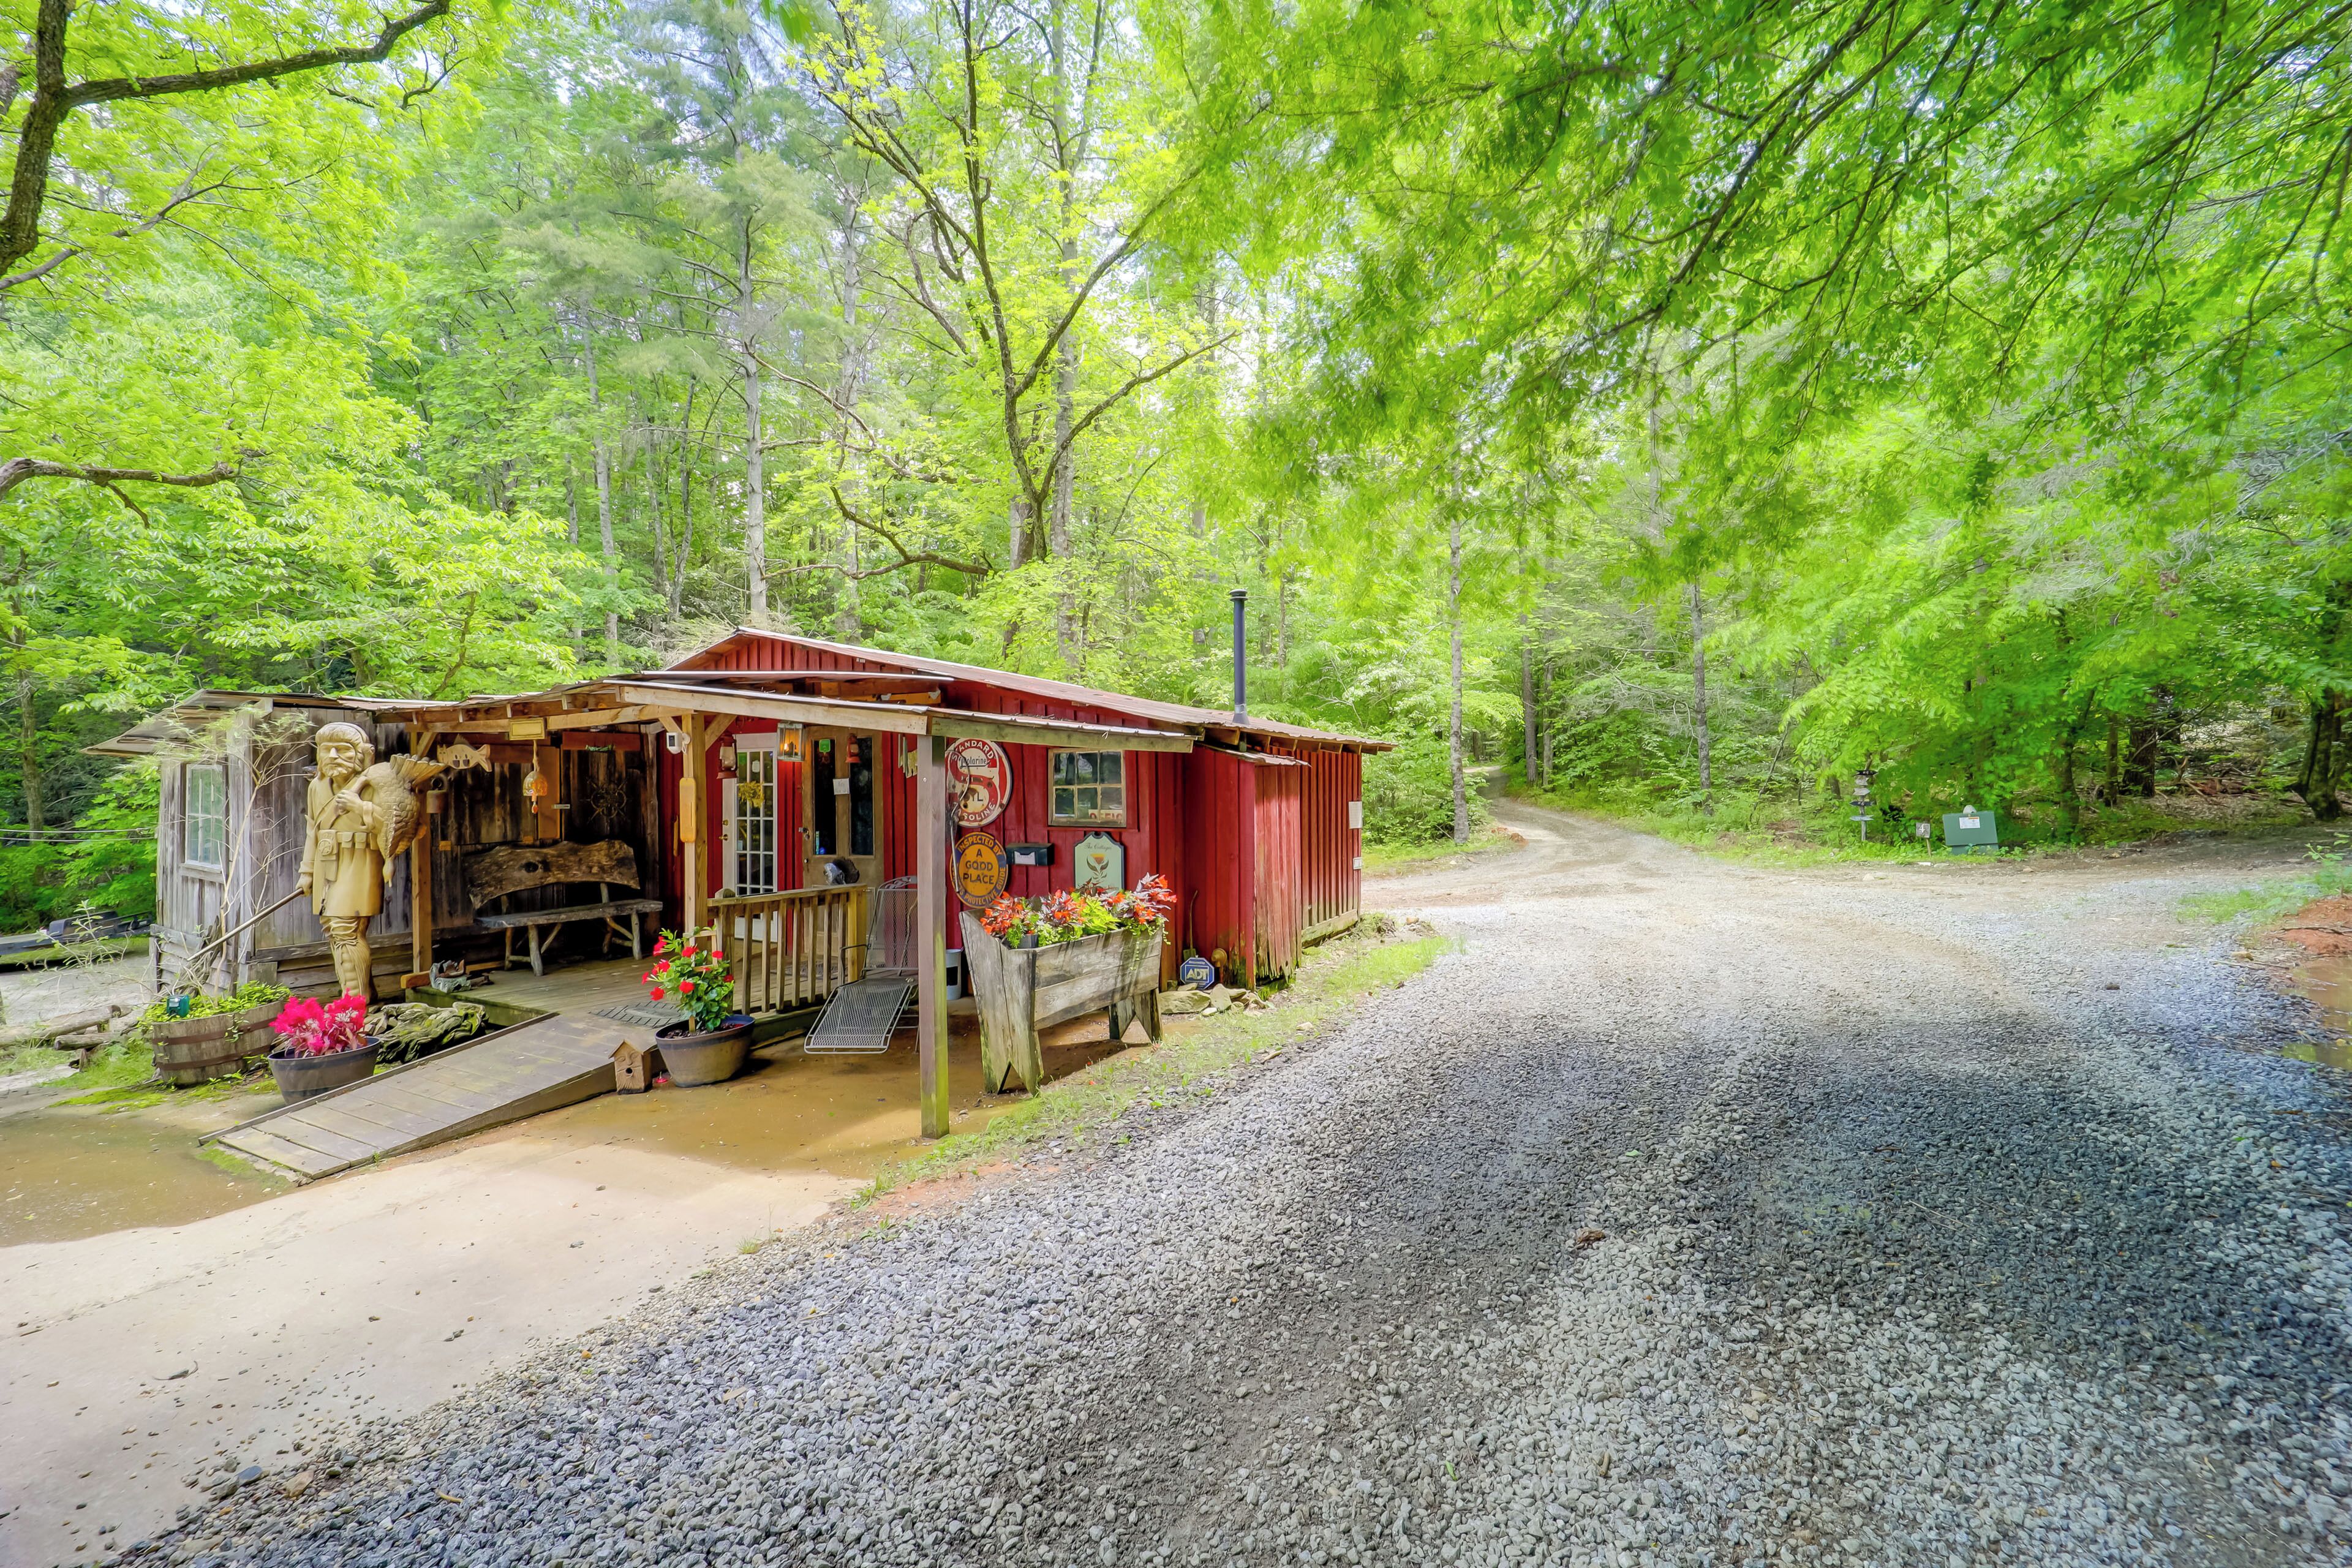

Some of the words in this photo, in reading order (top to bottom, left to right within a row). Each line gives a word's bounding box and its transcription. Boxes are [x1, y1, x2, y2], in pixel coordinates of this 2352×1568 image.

[952, 741, 995, 761] SANDARD
[954, 801, 995, 821] SOLINE
[1919, 823, 1925, 833] 4
[957, 835, 994, 852] INSPECTED
[993, 845, 1003, 855] BY
[976, 848, 983, 858] A
[965, 860, 993, 872] GOOD
[962, 873, 995, 884] PLACE
[964, 889, 999, 905] PROTECTIVE
[1186, 968, 1208, 980] ADT
